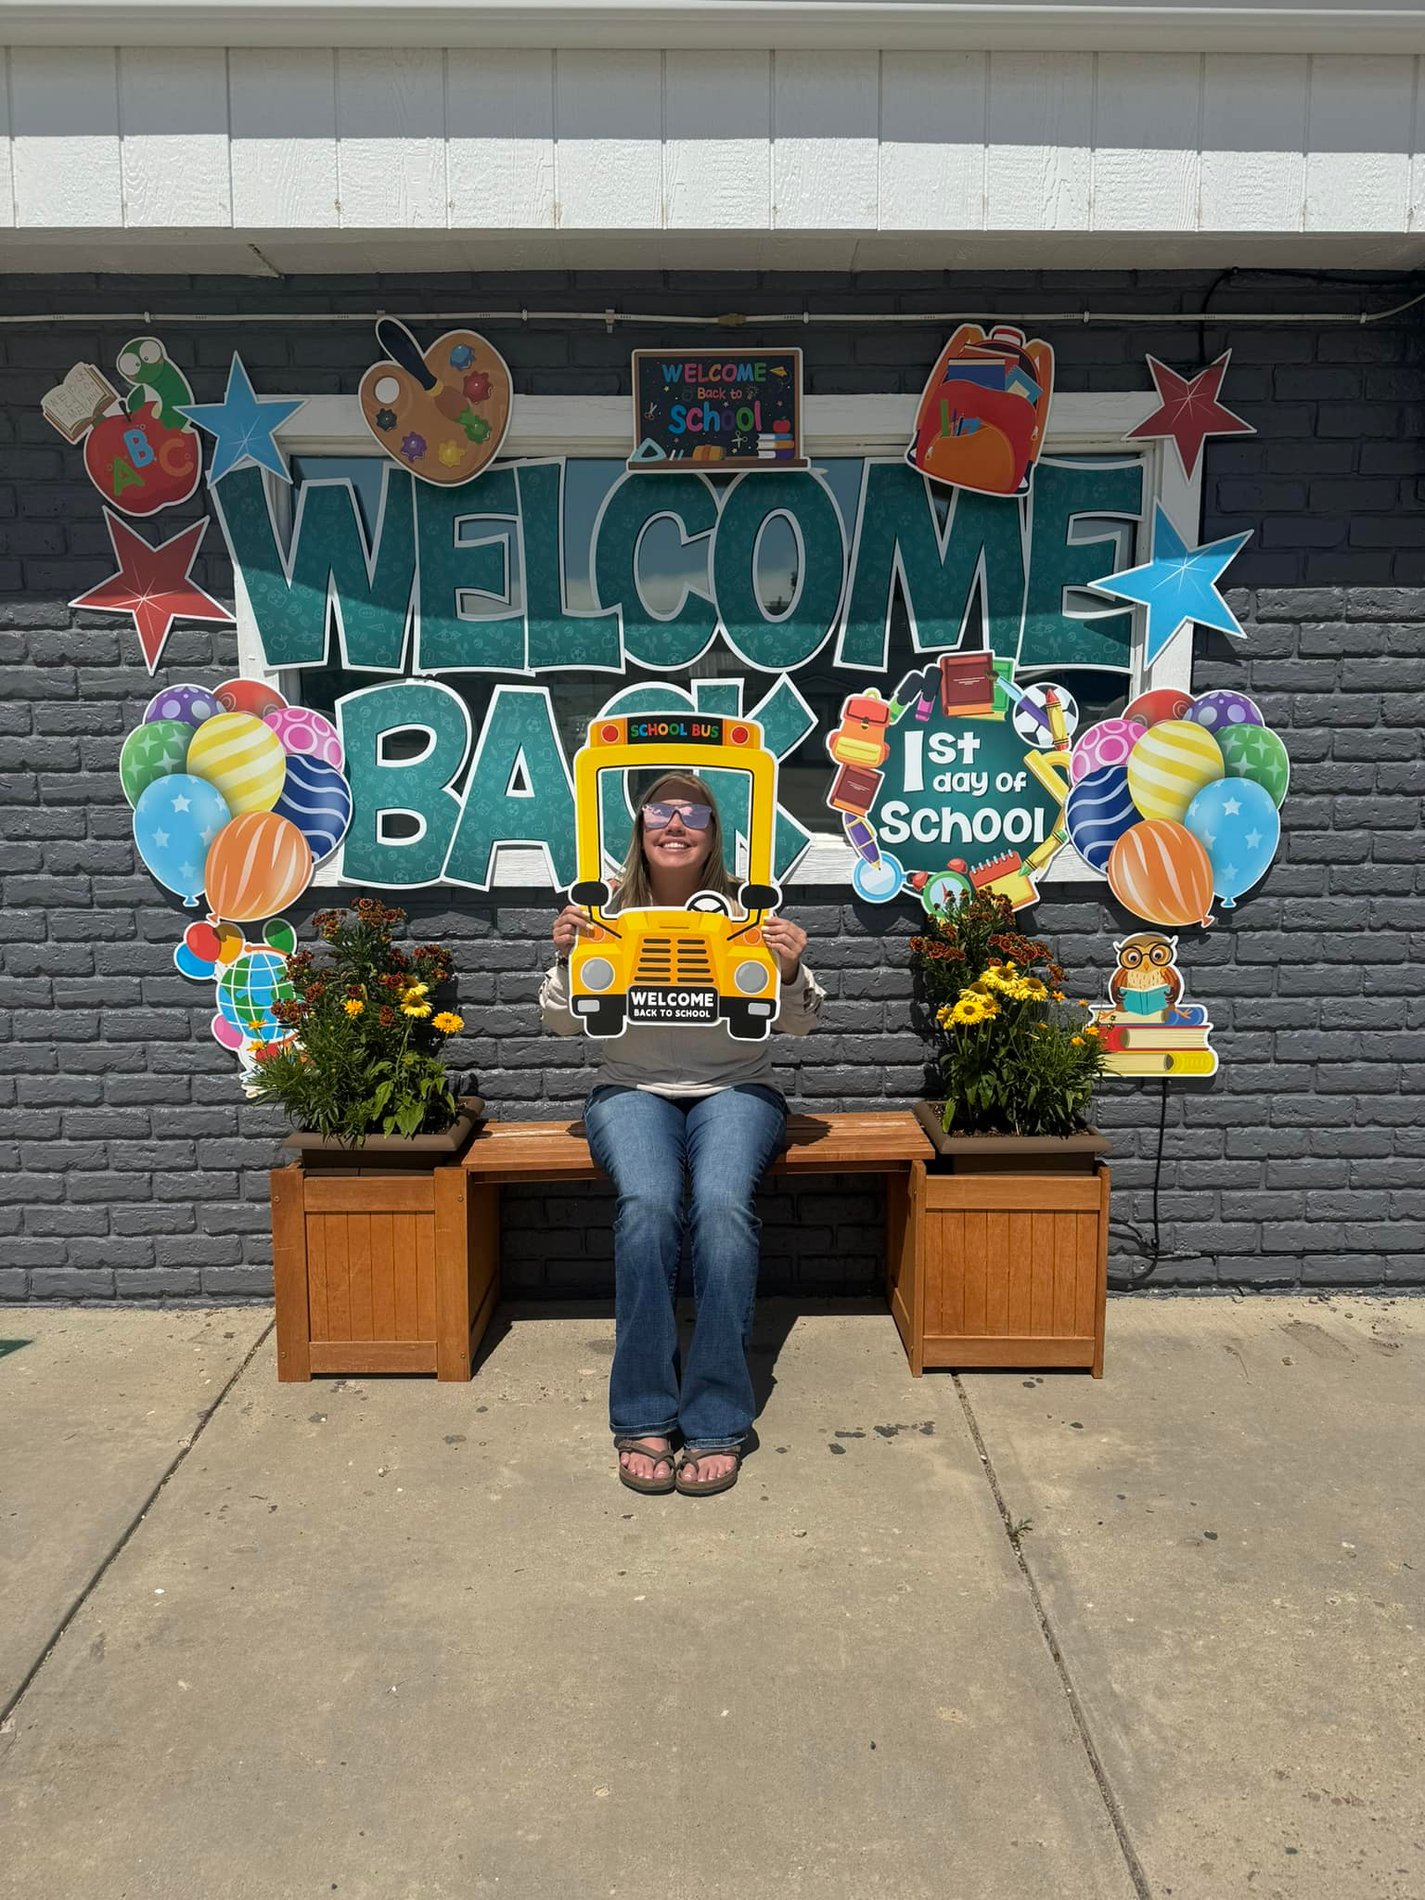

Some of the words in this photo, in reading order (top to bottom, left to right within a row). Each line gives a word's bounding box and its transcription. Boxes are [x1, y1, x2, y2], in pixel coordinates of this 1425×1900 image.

[662, 362, 767, 384] WELCOME
[697, 387, 726, 400] Back
[730, 388, 742, 400] to
[667, 400, 762, 434] School
[113, 428, 194, 497] ABC
[208, 456, 1148, 677] WELCOME
[630, 723, 688, 737] SCHOOL
[691, 724, 719, 738] BUS
[932, 771, 989, 797] day
[995, 772, 1027, 793] of
[879, 800, 1045, 844] School
[630, 991, 715, 1007] WELCOME
[634, 1009, 657, 1017] BACK
[660, 1009, 673, 1017] TO
[675, 1009, 711, 1018] SCHOOL
